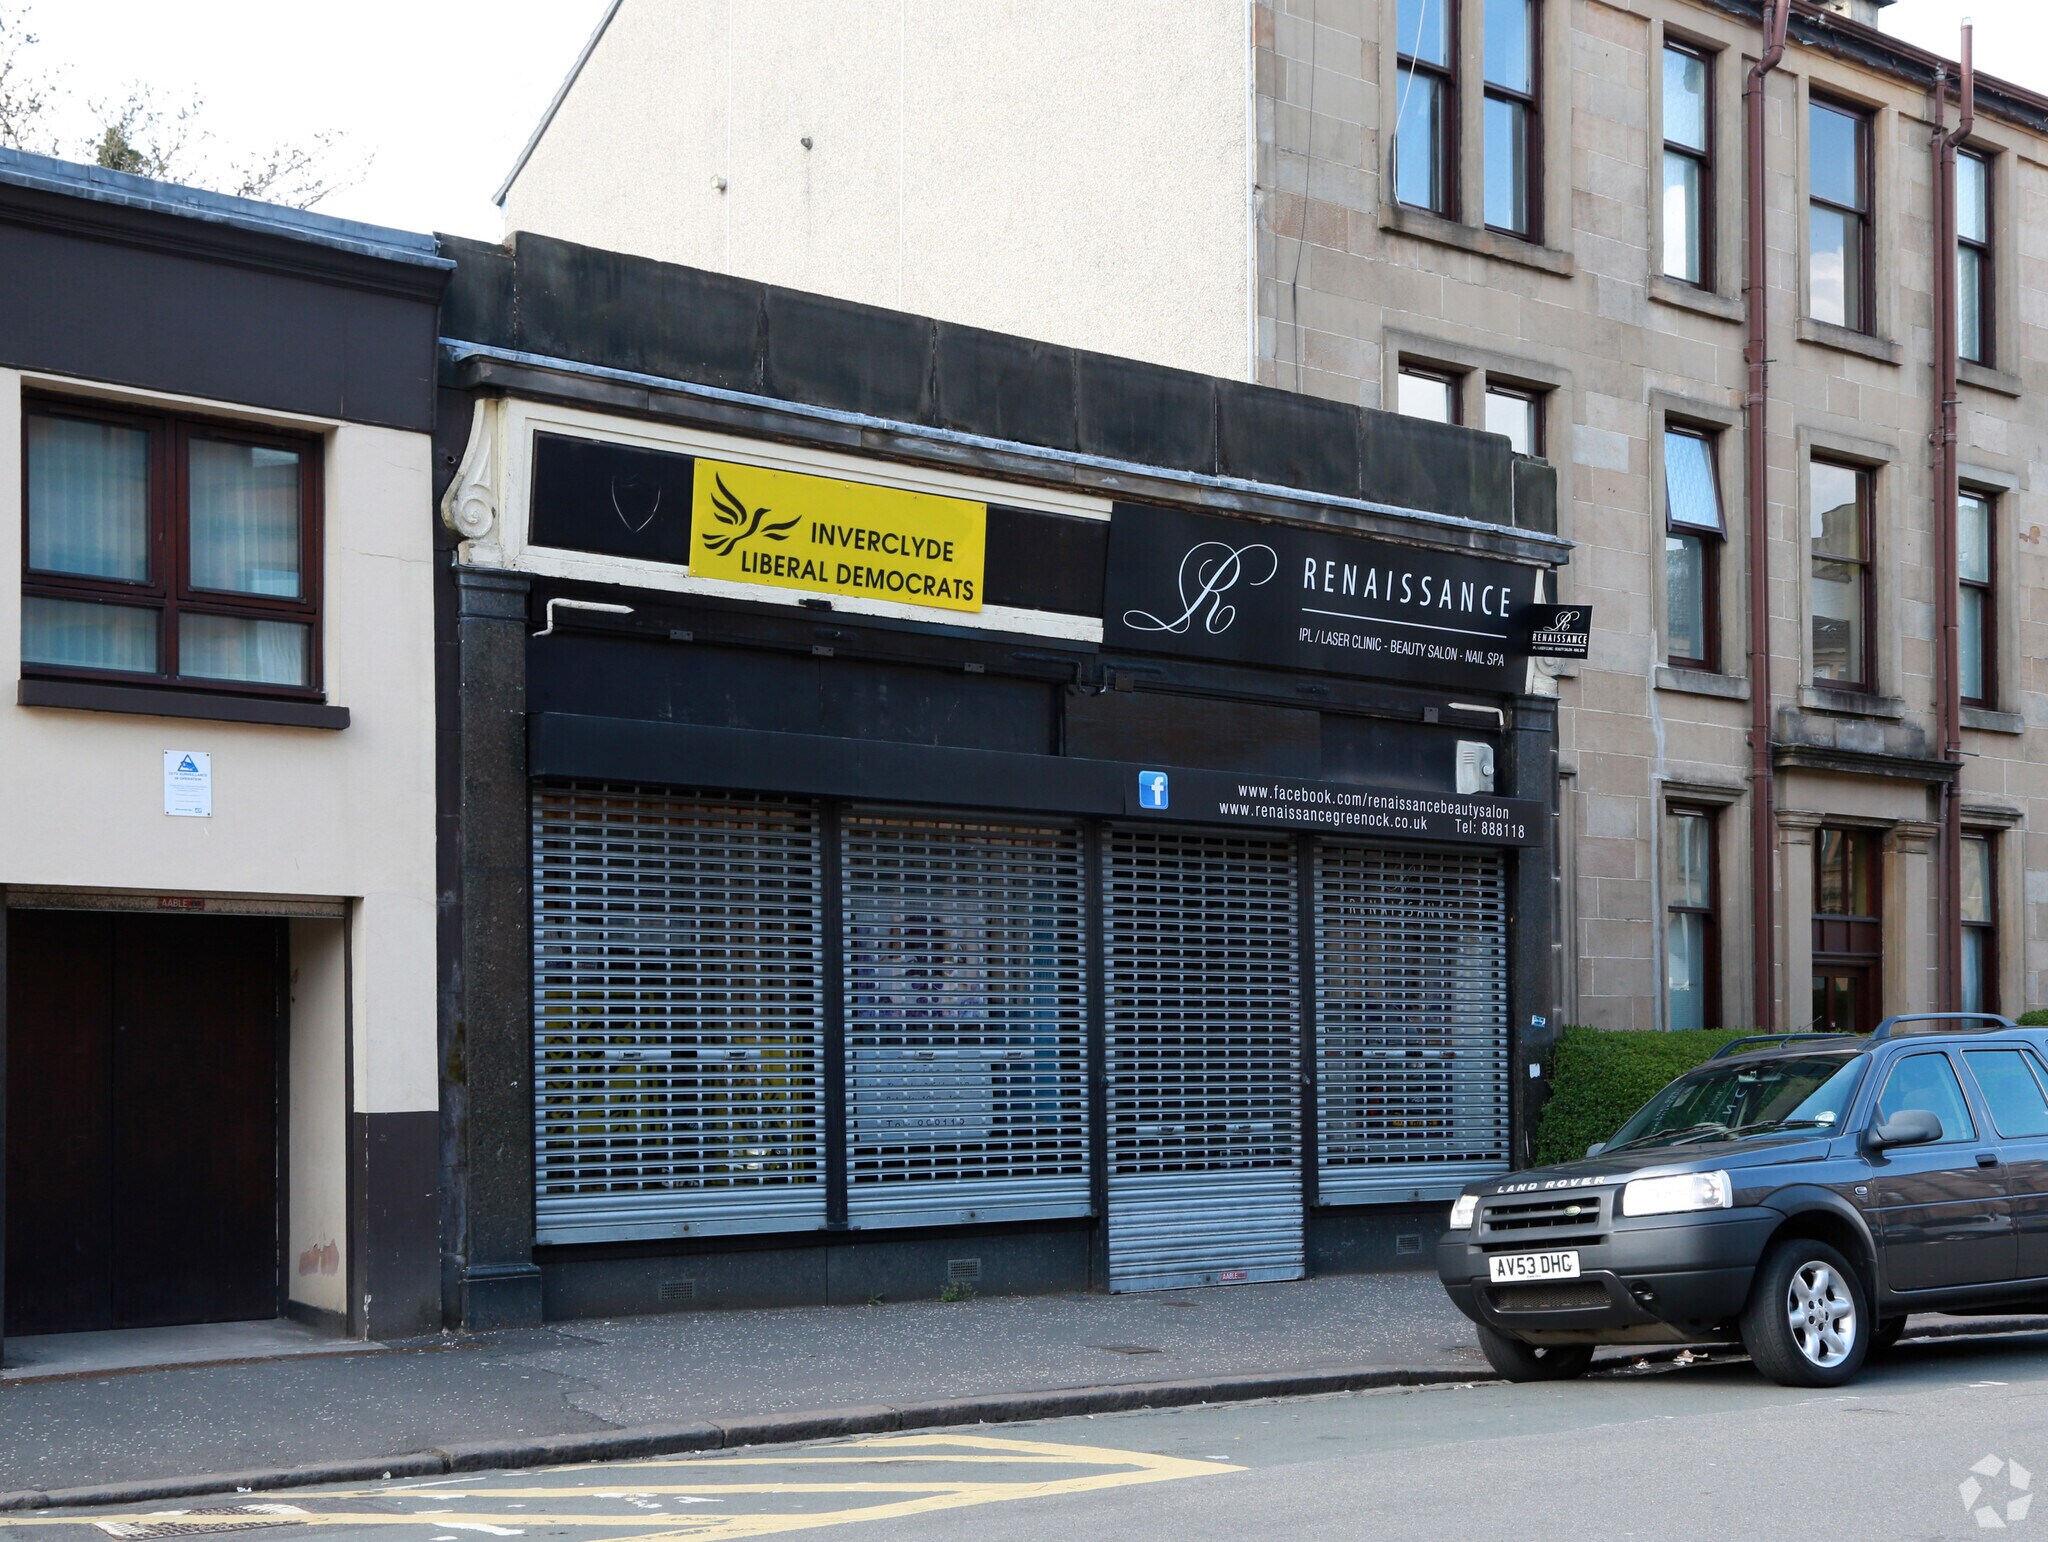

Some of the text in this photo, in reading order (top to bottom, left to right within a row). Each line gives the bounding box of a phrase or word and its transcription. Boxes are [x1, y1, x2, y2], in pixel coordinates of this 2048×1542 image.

[811, 522, 954, 562] INVERCLYDE
[741, 550, 974, 601] LIBERAL DEMOCRATS
[1303, 557, 1512, 618] RENAISSANCE
[1299, 628, 1313, 643] IPL
[1321, 631, 1350, 648] LASER
[1352, 635, 1382, 652] CLINIC
[1390, 639, 1427, 658] BEAUTY
[1427, 644, 1459, 661] SALON
[1465, 649, 1486, 665] NAIL
[1487, 652, 1505, 668] SPA
[1532, 632, 1588, 645] RENAISSANCE
[1219, 801, 1526, 839] www.renaissancegreenock.co.uk Tel: 888118
[1238, 784, 1510, 820] www.facebook.com/renaissancebeautysalon
[161, 898, 188, 908] AABLE
[1497, 1176, 1605, 1194] LAND ROVER
[1497, 1256, 1536, 1277] AV53
